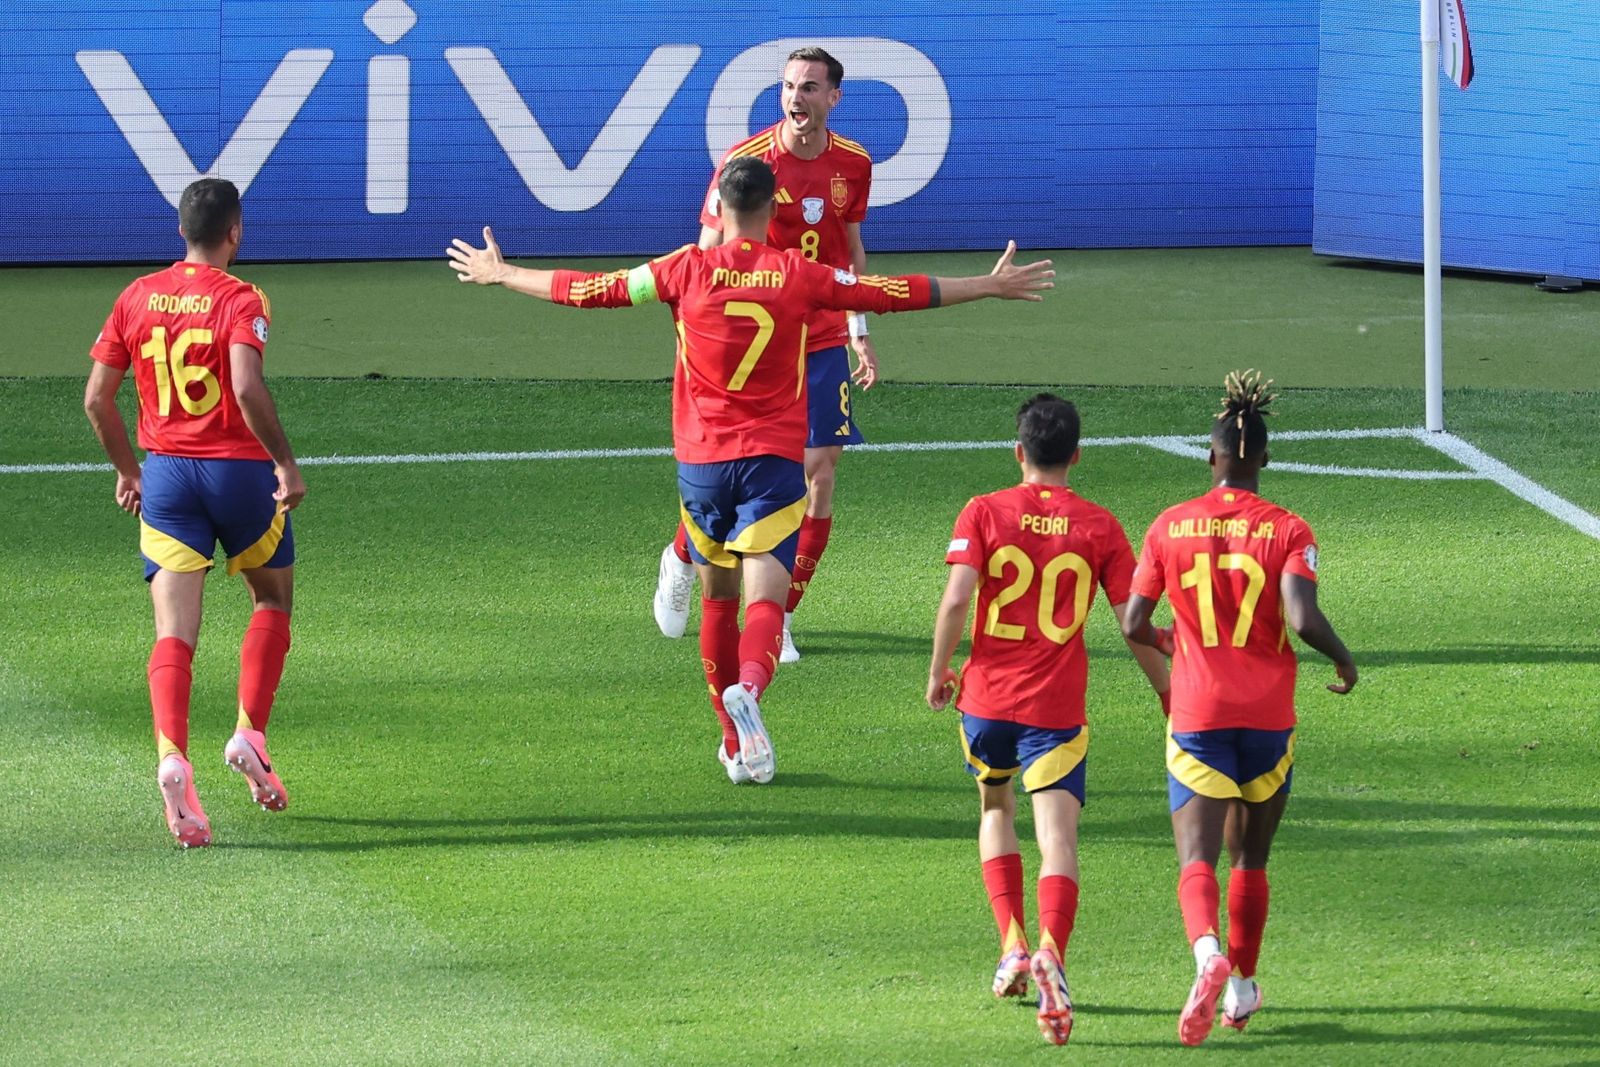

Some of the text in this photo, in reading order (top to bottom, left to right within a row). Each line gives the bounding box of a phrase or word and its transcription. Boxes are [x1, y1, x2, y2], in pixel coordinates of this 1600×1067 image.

[1446, 2, 1457, 38] BERLIN
[75, 0, 952, 214] vivo
[800, 230, 820, 262] 8
[712, 267, 783, 288] MORATA
[148, 293, 212, 314] RODRIGO
[723, 301, 775, 392] 7
[140, 326, 222, 417] 16
[839, 380, 850, 417] 8
[1020, 513, 1070, 536] PEDRI
[1168, 517, 1248, 539] WILLIAMS
[983, 544, 1093, 645] 20
[1180, 552, 1267, 648] 17
